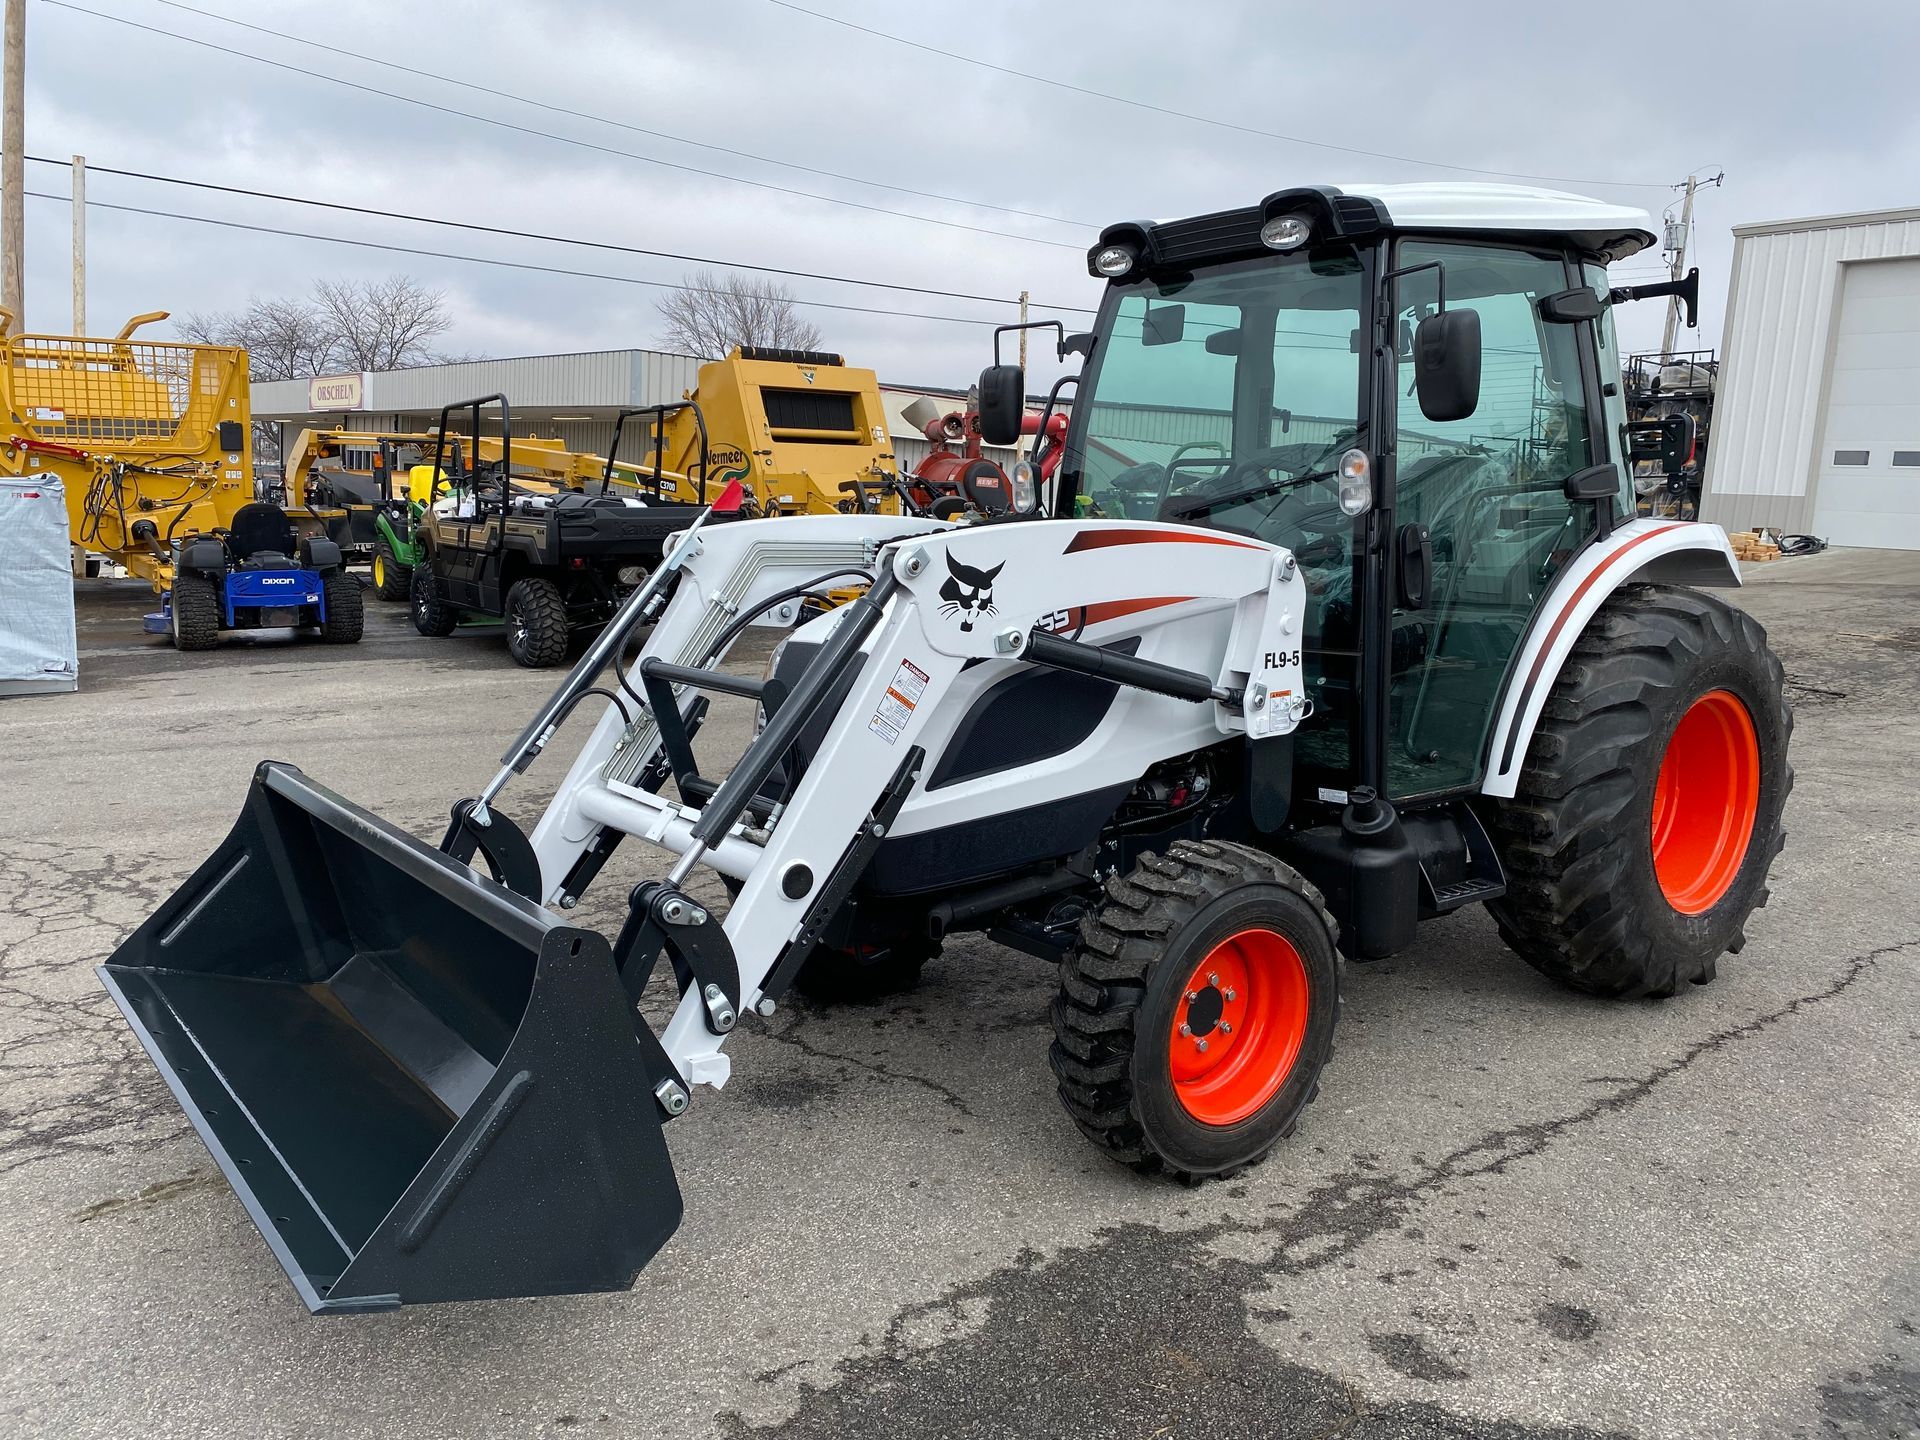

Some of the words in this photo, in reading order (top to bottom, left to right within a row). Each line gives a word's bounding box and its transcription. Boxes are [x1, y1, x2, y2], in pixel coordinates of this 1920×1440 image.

[317, 384, 354, 401] ORSCHELN
[706, 450, 743, 465] Vermeer
[1264, 650, 1300, 669] FL9-5
